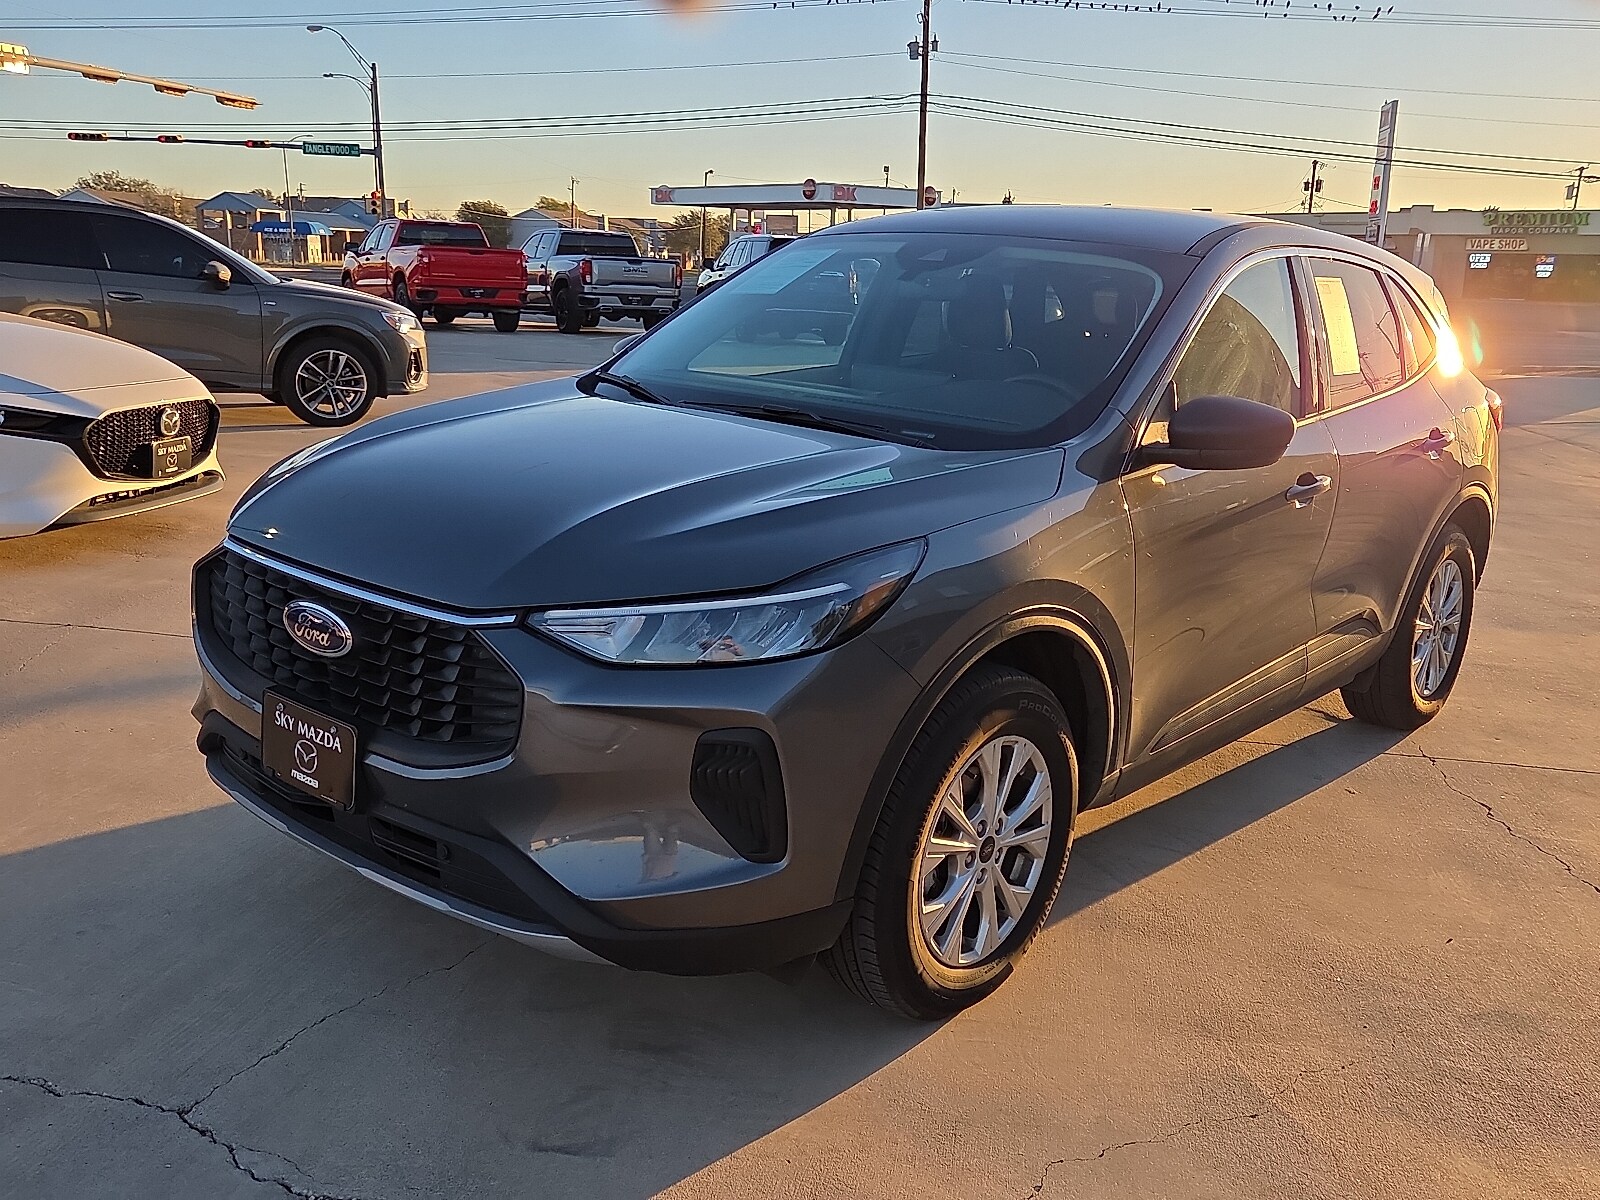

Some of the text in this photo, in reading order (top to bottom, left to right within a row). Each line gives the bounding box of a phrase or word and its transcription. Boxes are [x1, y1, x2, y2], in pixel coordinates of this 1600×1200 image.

[305, 144, 350, 155] TANGLEWOOD
[655, 188, 673, 202] DK
[833, 184, 858, 202] DK
[1483, 211, 1591, 227] PREMIUM
[1492, 227, 1524, 235] VAPOR
[1470, 239, 1526, 249] VAPE SHOP
[168, 444, 187, 453] MAZDA
[294, 611, 332, 648] Ford
[274, 710, 342, 754] SKY MAZDA
[291, 768, 319, 789] mazda
